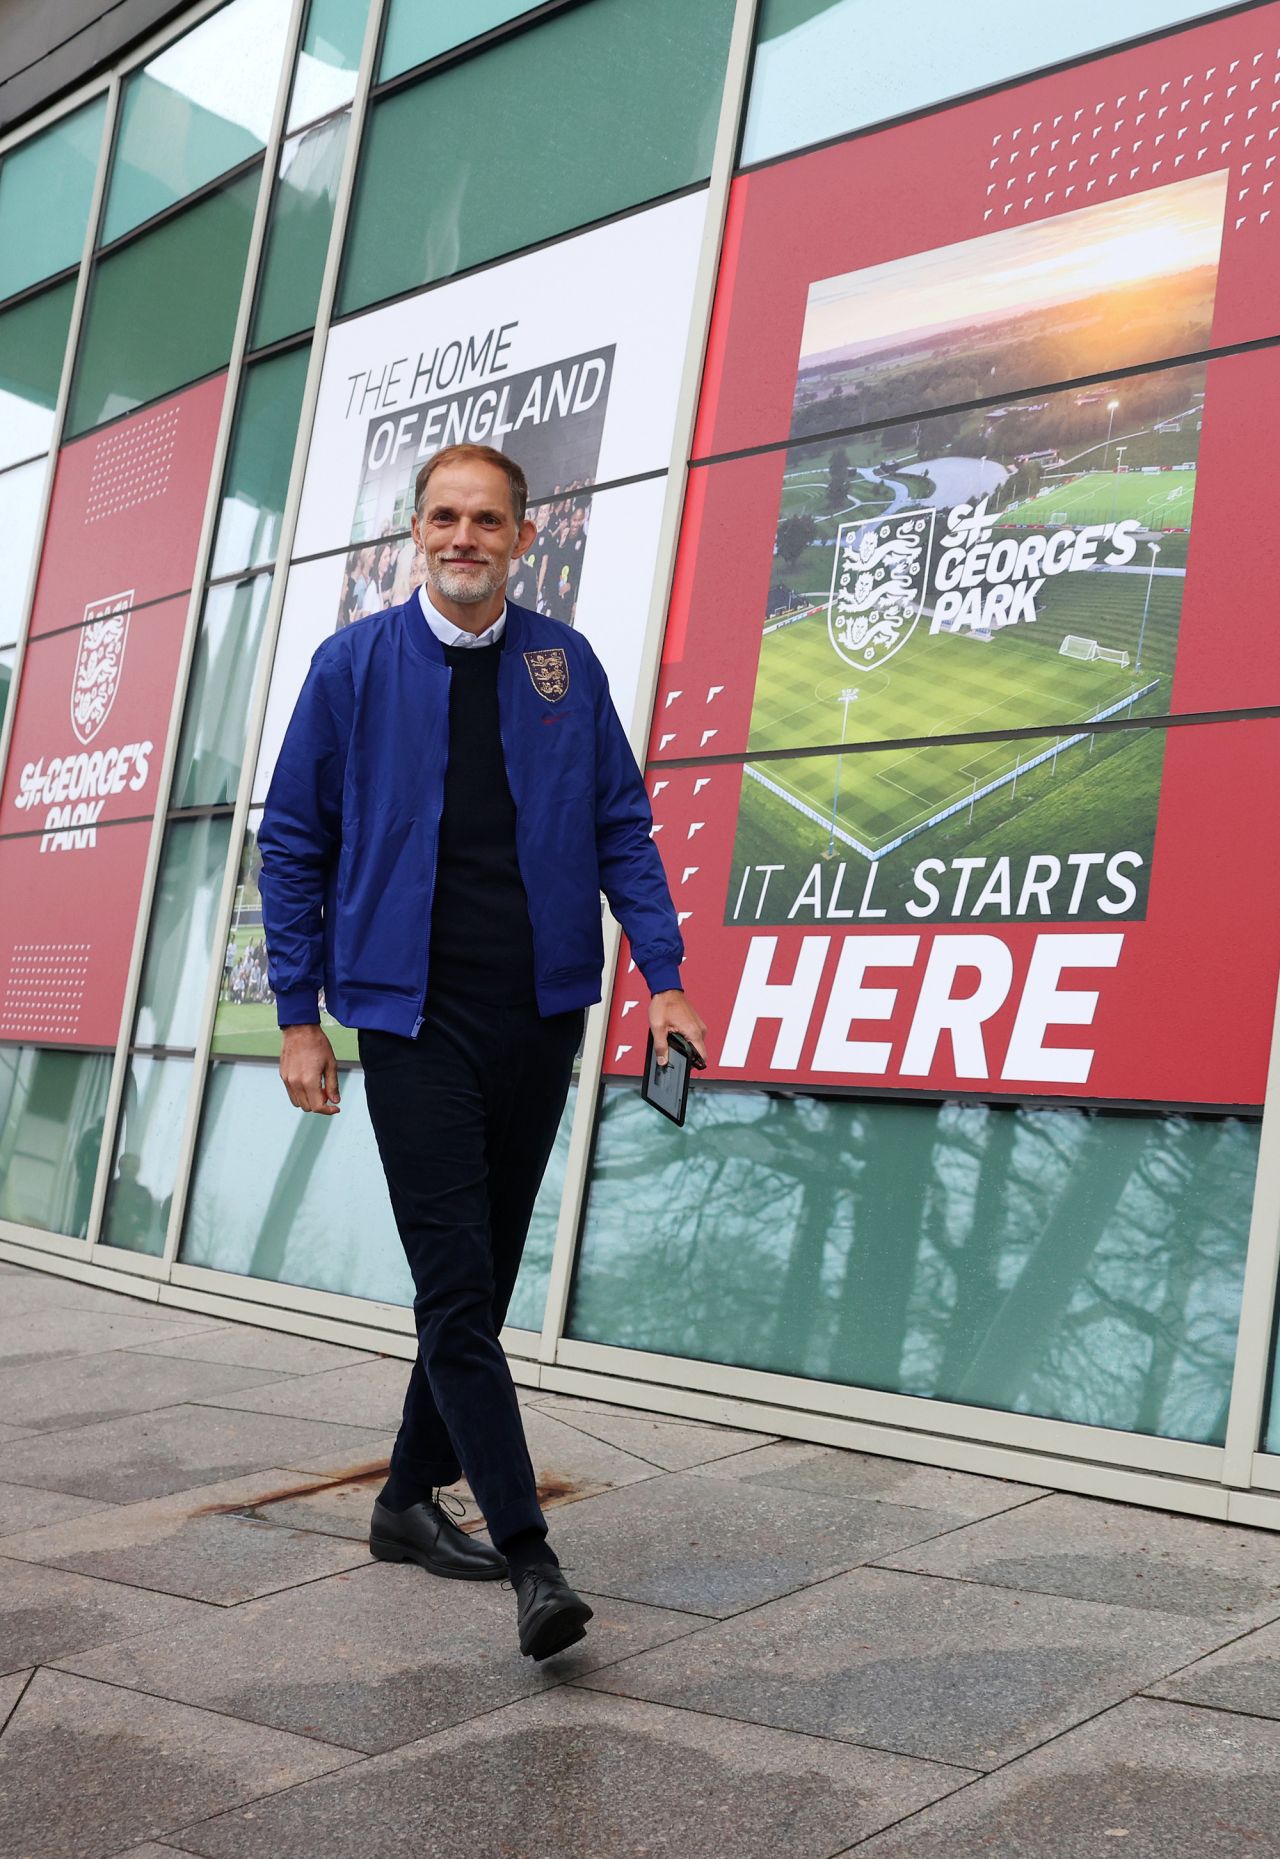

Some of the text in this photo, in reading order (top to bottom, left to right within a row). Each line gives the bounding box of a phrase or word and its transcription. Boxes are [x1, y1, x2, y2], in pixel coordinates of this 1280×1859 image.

[346, 321, 519, 419] THE HOME
[368, 357, 606, 470] OF ENGLAND
[934, 519, 1141, 591] GEORGE'S
[929, 578, 1047, 635] PARK
[42, 740, 153, 805] GEORGE'S
[40, 800, 105, 852] PARK
[733, 850, 1144, 920] IT ALL STARTS
[718, 933, 1125, 1084] HERE
